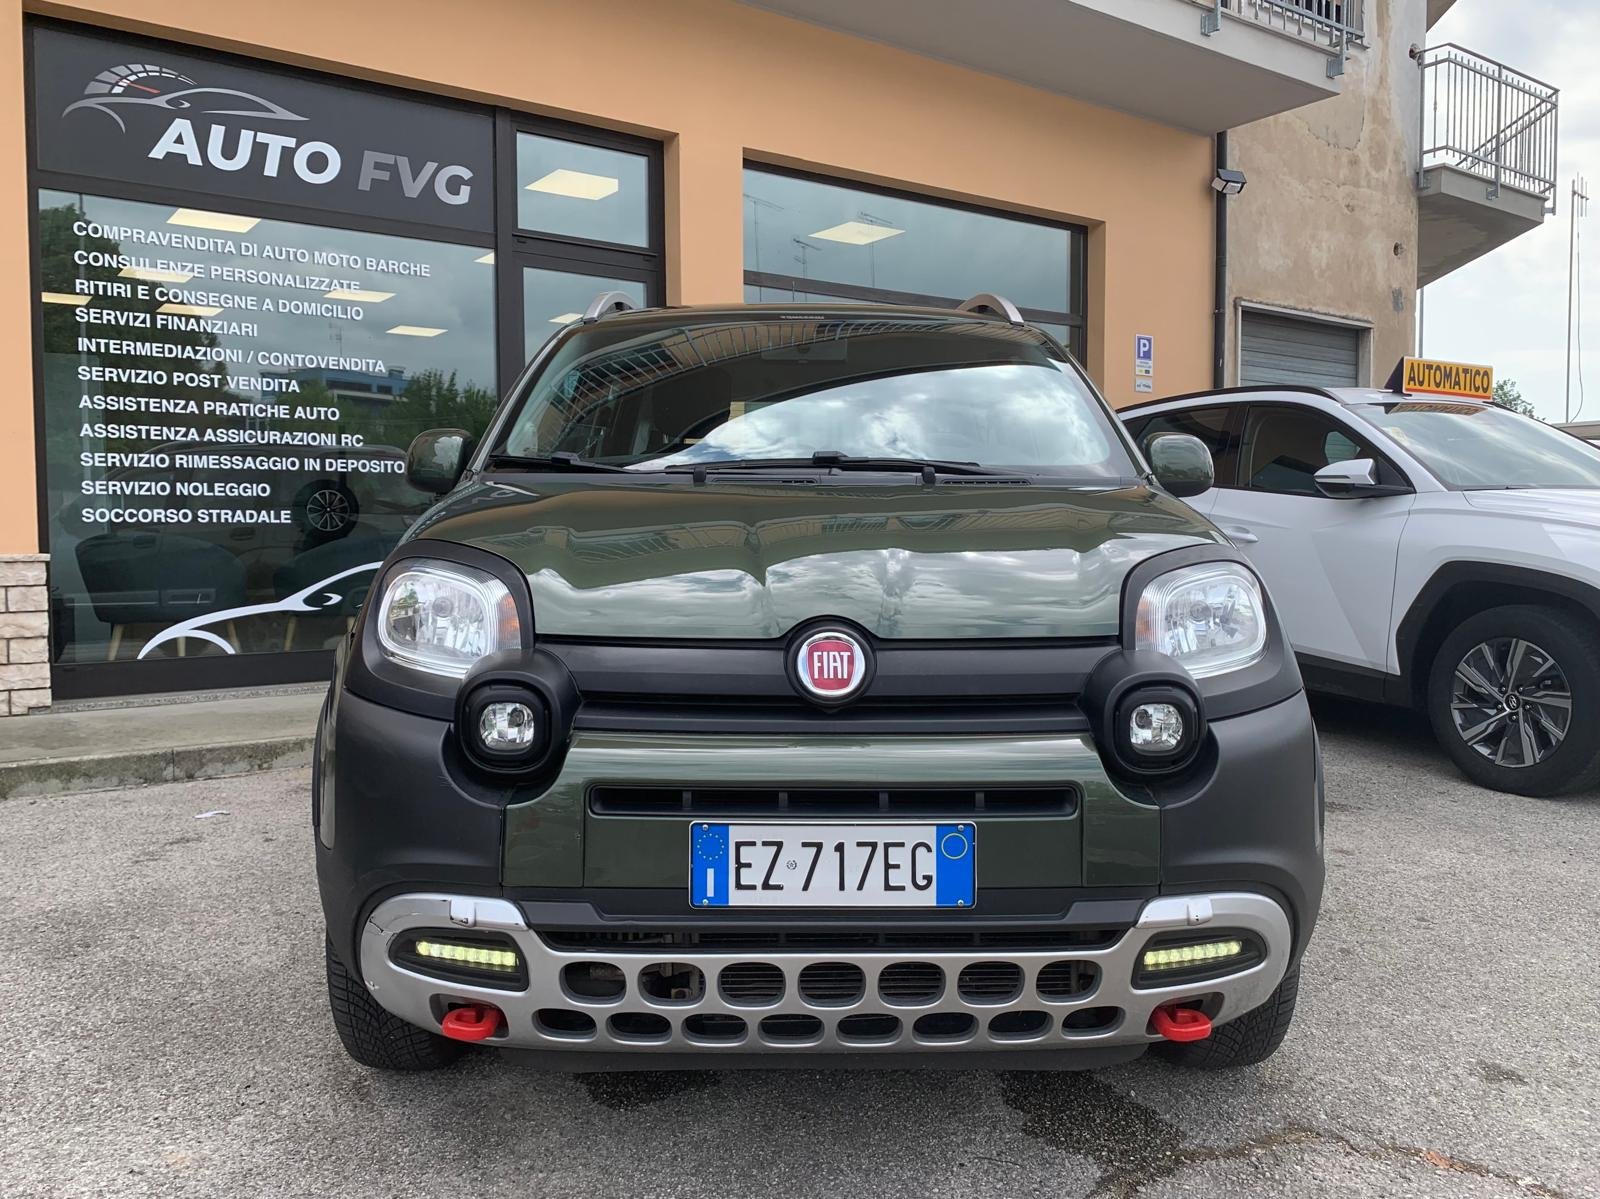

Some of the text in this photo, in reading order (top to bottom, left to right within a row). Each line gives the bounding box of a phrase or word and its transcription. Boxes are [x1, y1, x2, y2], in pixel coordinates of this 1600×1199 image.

[148, 117, 474, 205] AUTO FVG
[73, 221, 430, 276] COMPRAVENDITA DI AUTO MOTO BARCHE
[74, 250, 360, 291] CONSULENZE PERSONALIZZATE
[75, 279, 364, 320] RITIRI E CONSEGNE A DOMICILIO
[75, 308, 257, 337] SERVIZI FINANZIARI
[78, 337, 242, 363] INTERMEDIAZIONI
[257, 351, 386, 373] CONTOVENDITA
[1140, 339, 1149, 357] P
[78, 366, 300, 393] SERVIZIO POST VENDITA
[1408, 362, 1490, 393] AUTOMATICO
[79, 395, 340, 421] ASSISTENZA PRATICHE AUTO
[79, 423, 364, 447] ASSISTENZA ASSICURAZIONI RC
[80, 452, 405, 474] SERVIZIO RIMESSAGGIO IN DEPOSITO
[81, 480, 271, 497] SERVIZIO NOLEGGIO
[81, 508, 291, 524] SOCCORSO STRADALE
[813, 651, 851, 679] FIAT
